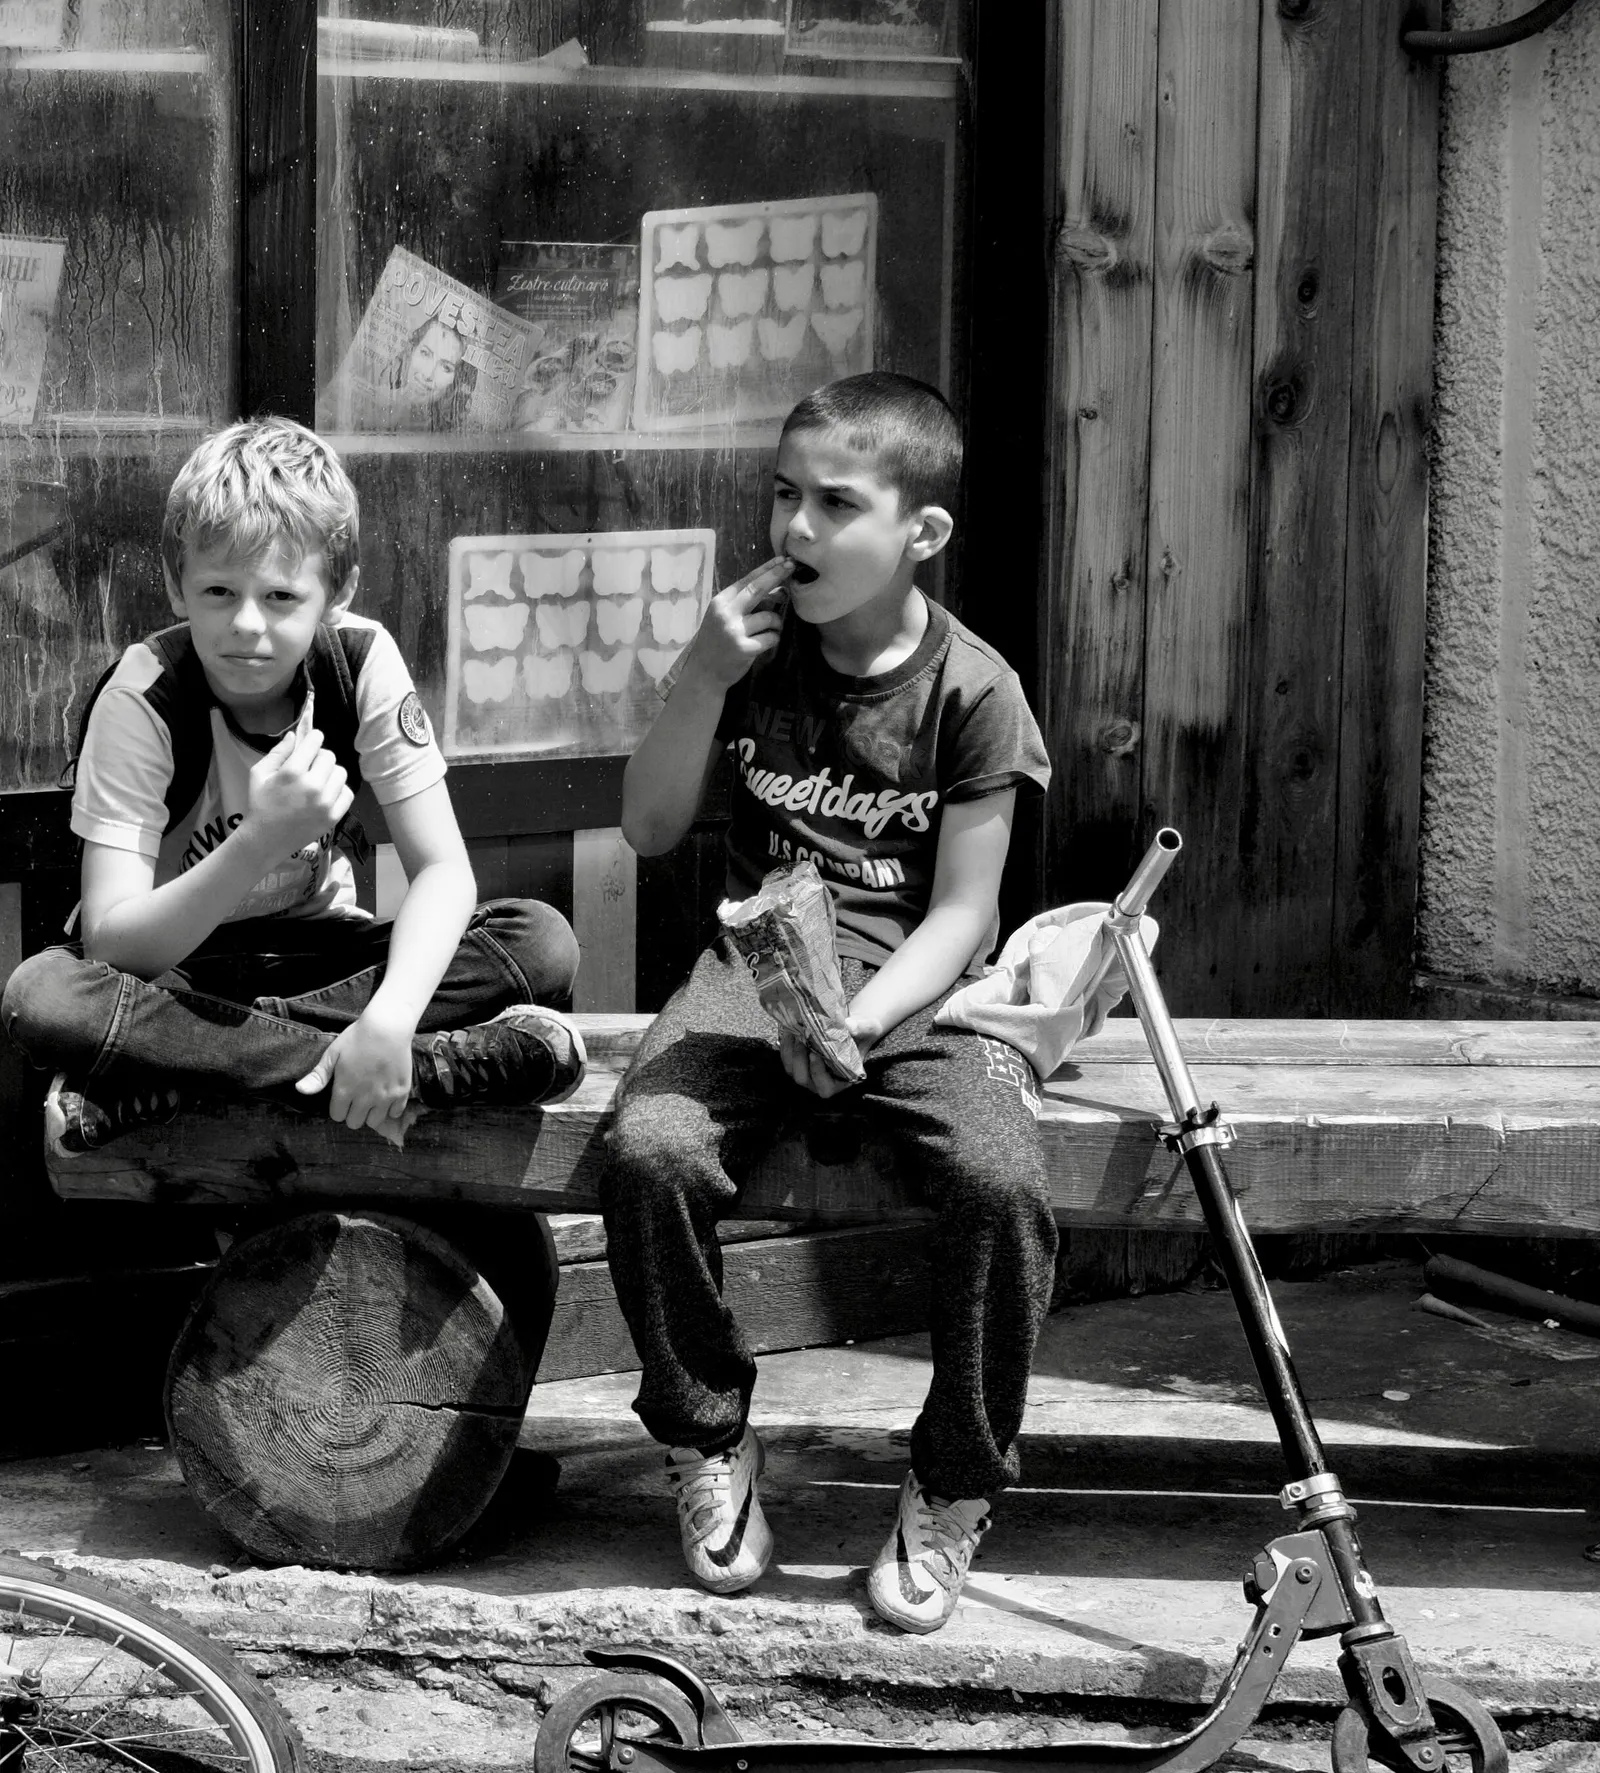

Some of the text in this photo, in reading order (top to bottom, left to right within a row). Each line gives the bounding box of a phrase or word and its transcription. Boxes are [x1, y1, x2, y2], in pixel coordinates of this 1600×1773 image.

[507, 273, 552, 291] Zestre
[384, 259, 526, 370] POVESTEA
[747, 701, 827, 747] NEW
